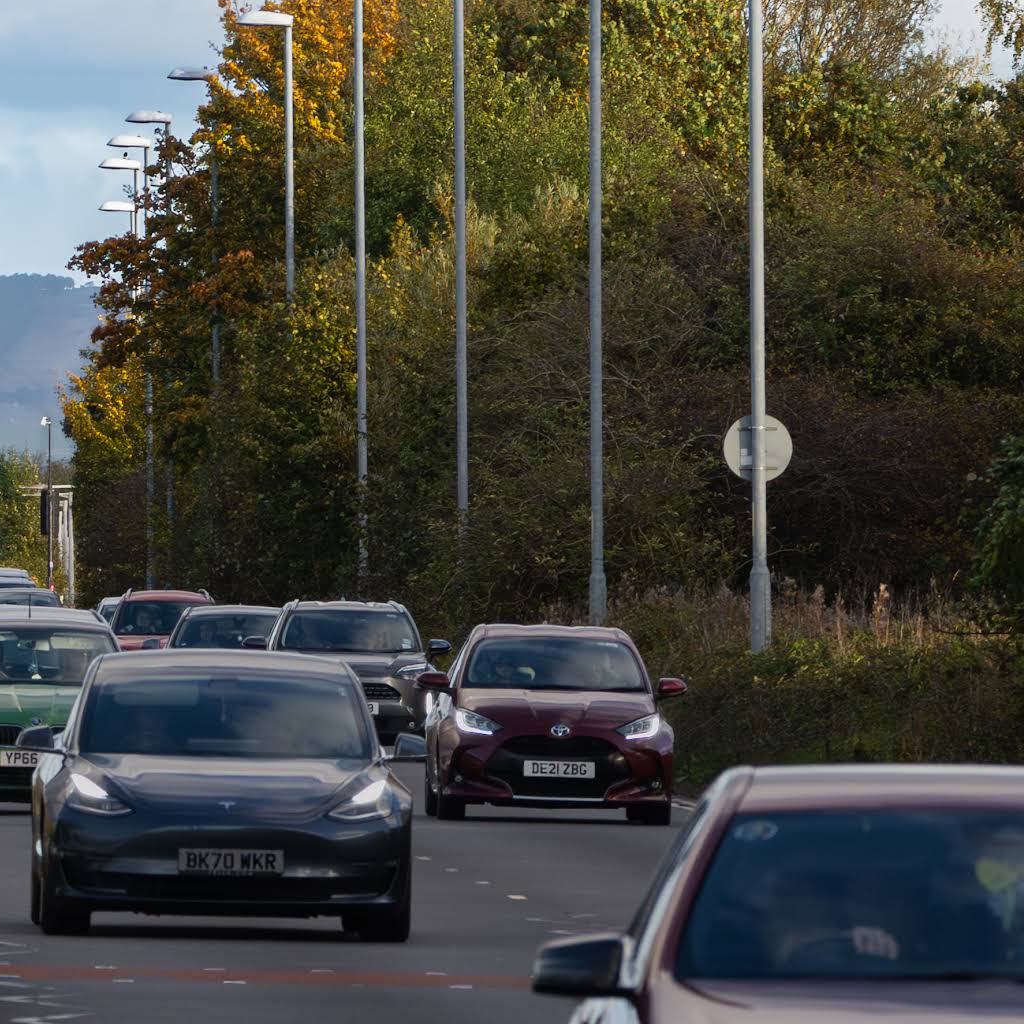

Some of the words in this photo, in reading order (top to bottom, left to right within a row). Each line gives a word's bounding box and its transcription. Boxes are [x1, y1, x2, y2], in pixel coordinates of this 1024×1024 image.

[6, 752, 38, 764] YP66
[532, 762, 560, 774] DE21
[563, 763, 587, 776] ZBG
[186, 852, 234, 869] BK70
[241, 853, 277, 870] WKR
